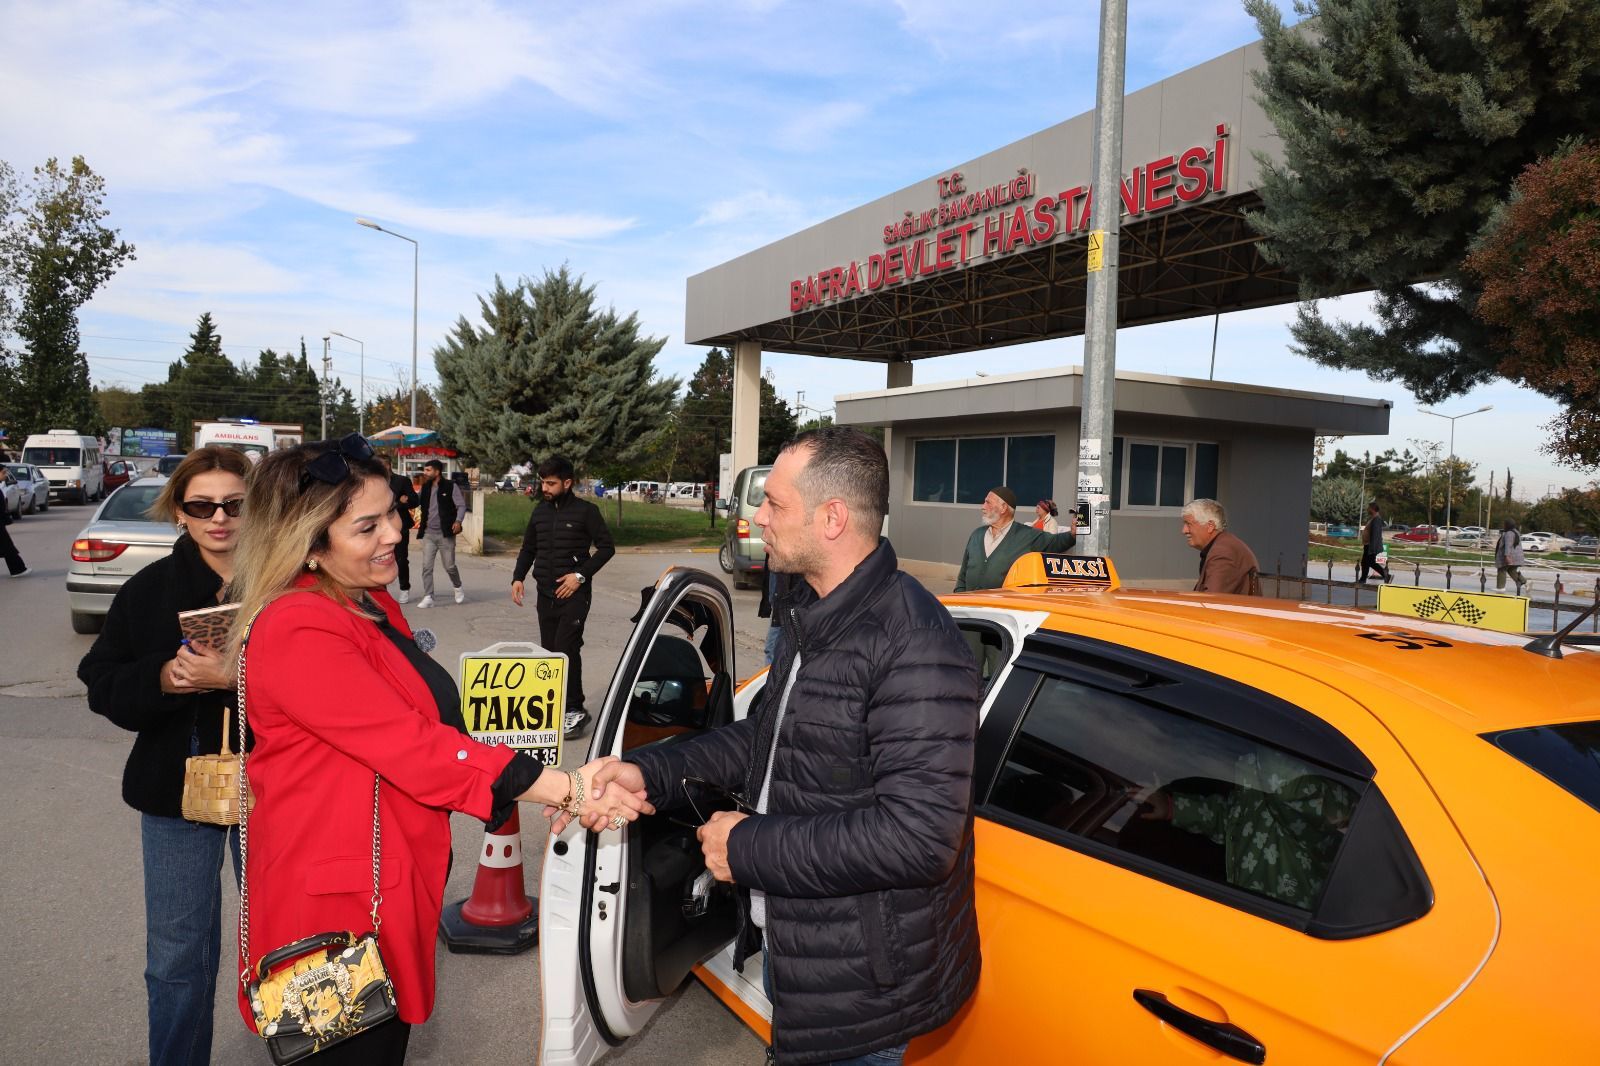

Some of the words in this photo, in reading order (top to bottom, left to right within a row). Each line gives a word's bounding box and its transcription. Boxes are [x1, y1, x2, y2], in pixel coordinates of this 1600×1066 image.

[937, 172, 966, 198] T.C.
[883, 210, 935, 244] SAĞLIK
[938, 167, 1033, 226] BAKANLIĞI
[790, 261, 862, 312] BAFRA
[867, 221, 974, 290] DEVLET
[471, 663, 526, 690] ALO
[542, 668, 559, 680] 24/7
[516, 734, 538, 744] PARK
[539, 732, 556, 743] YERİ
[542, 748, 557, 766] 35
